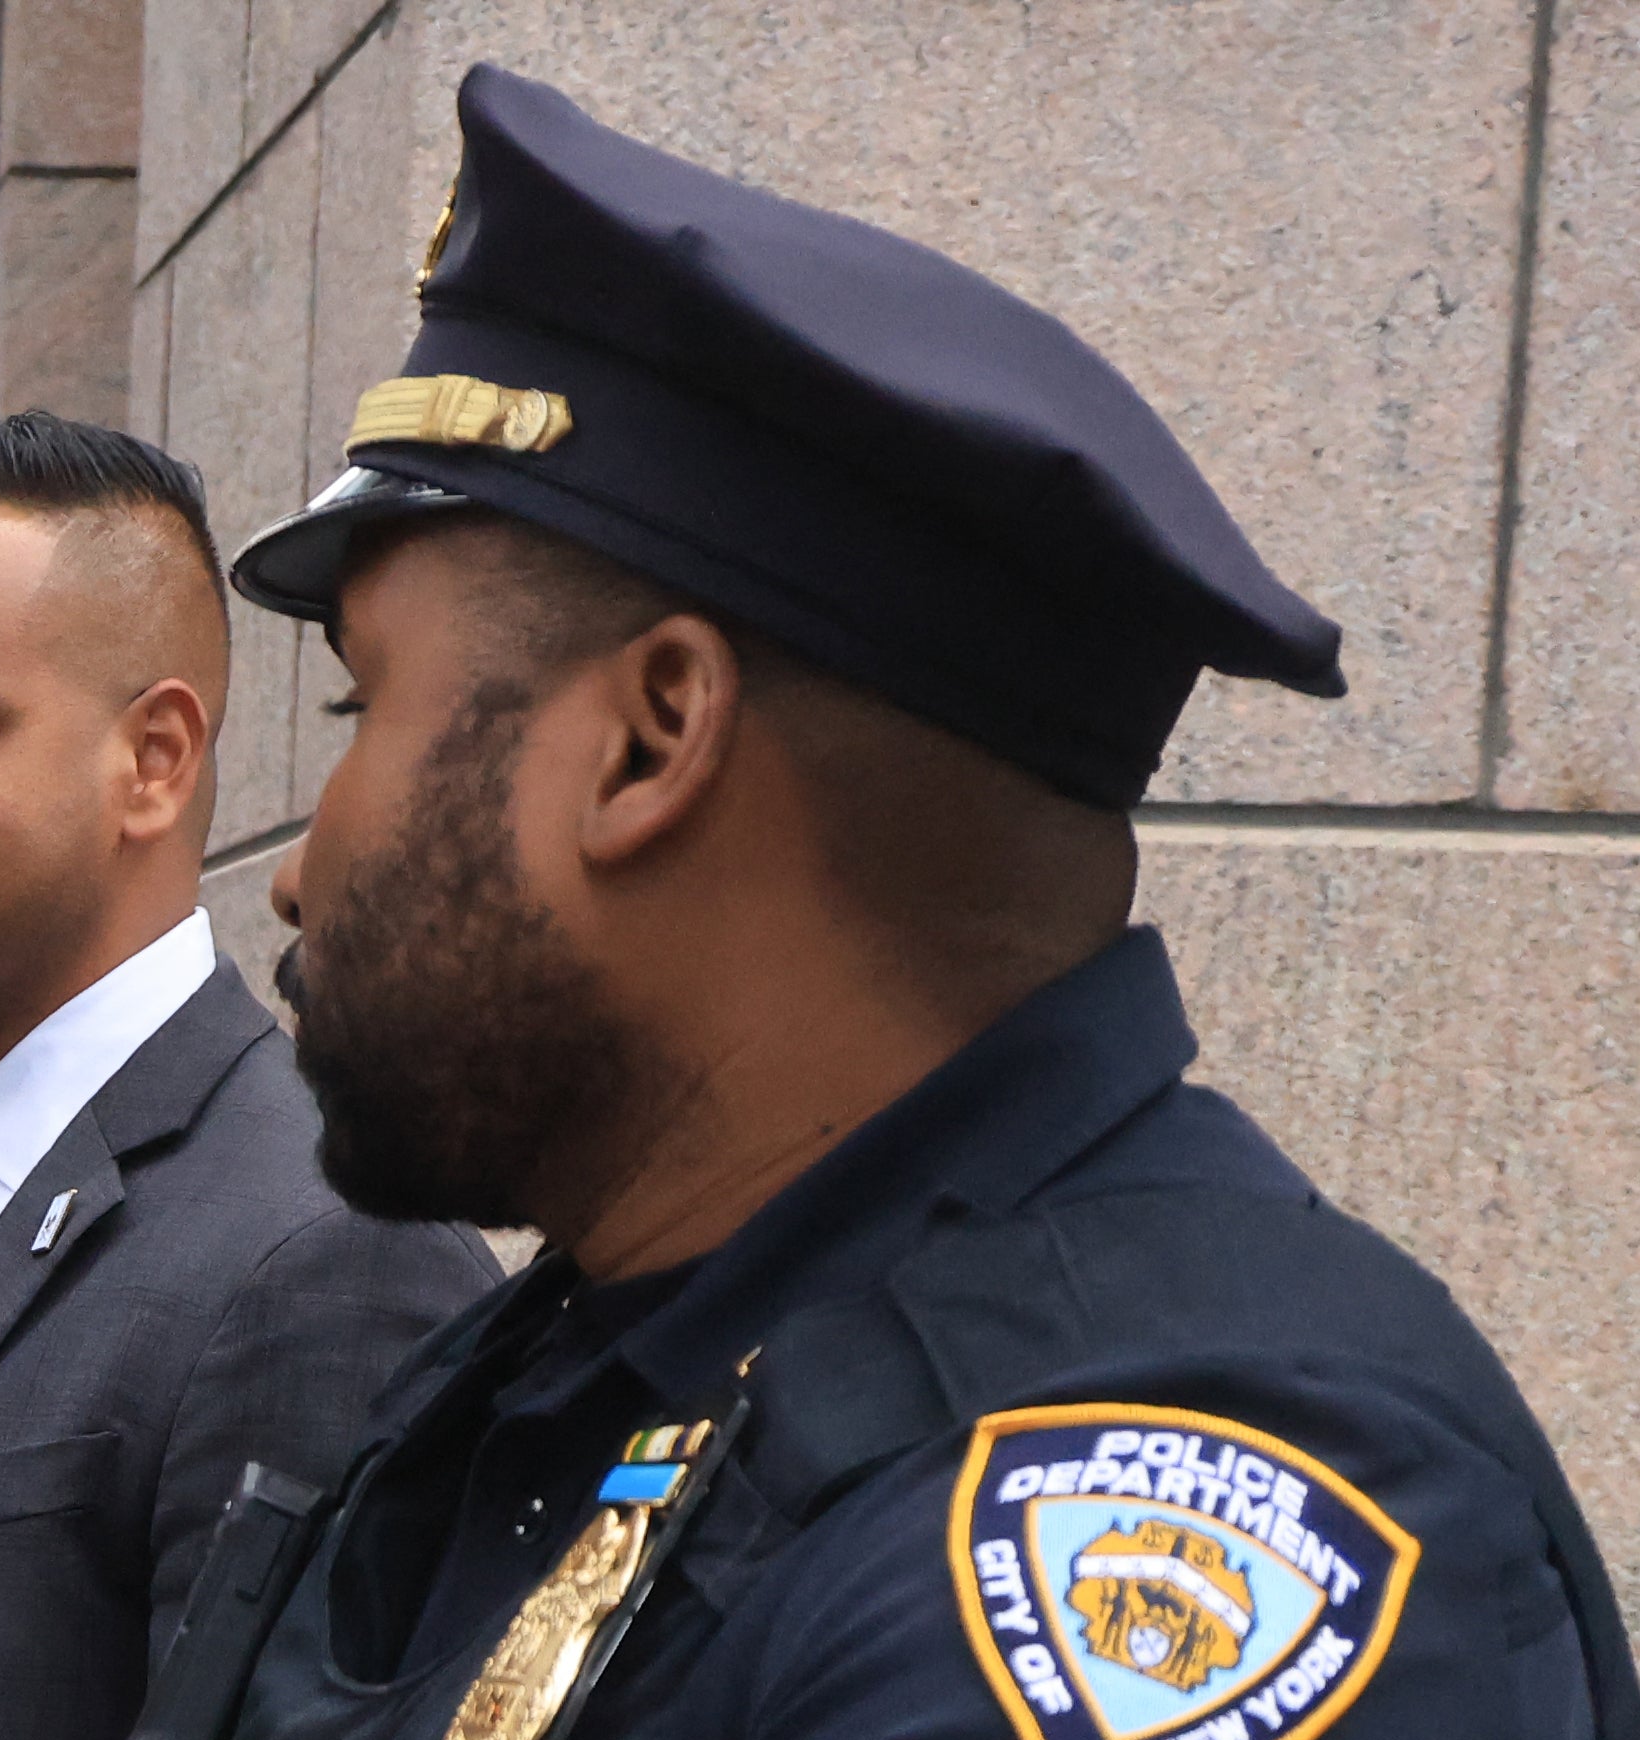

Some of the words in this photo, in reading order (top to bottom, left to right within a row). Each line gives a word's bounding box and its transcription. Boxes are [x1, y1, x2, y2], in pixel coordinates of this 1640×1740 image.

[997, 1460, 1361, 1606] DEPARTMENT
[1094, 1430, 1308, 1519] POLICE
[974, 1539, 1039, 1634] CITY
[1010, 1644, 1072, 1714] OF
[1242, 1625, 1354, 1730] YORK
